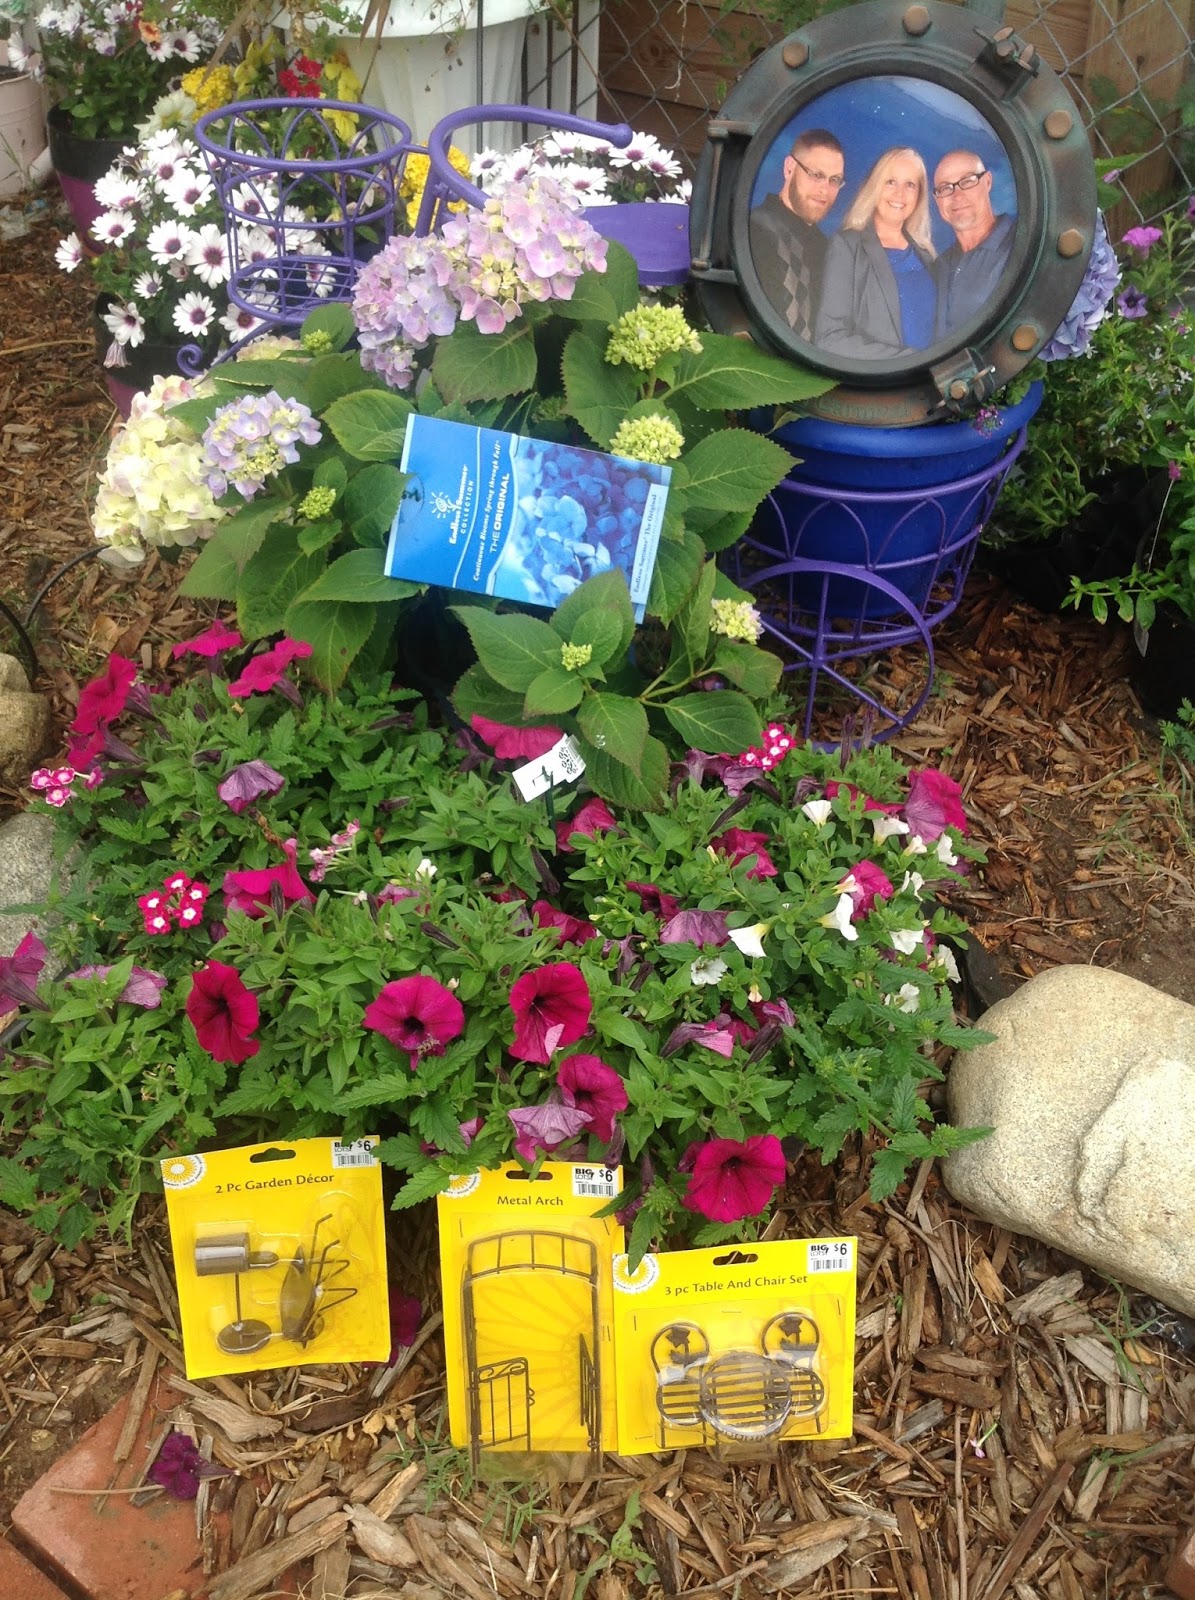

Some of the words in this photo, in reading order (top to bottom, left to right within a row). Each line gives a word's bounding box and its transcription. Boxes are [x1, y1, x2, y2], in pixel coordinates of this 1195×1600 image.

[489, 460, 500, 489] through
[460, 480, 474, 534] COLLECTION
[484, 490, 495, 514] Spring
[494, 473, 510, 531] ORIGINAL
[647, 494, 657, 522] Original
[479, 514, 490, 541] Blooms
[490, 531, 500, 553] THE
[473, 542, 485, 582] Continuous
[357, 1140, 371, 1151] $6
[215, 1185, 223, 1194] 2
[227, 1183, 241, 1192] Pc
[245, 1177, 292, 1190] Garden
[296, 1174, 335, 1185] Décor
[599, 1169, 613, 1182] $6
[497, 1196, 531, 1205] Metal
[536, 1196, 563, 1206] Arch
[810, 1244, 828, 1252] BIG
[834, 1243, 847, 1255] $6
[665, 1286, 671, 1295] 3
[675, 1287, 689, 1296] pc
[692, 1281, 724, 1292] Table
[727, 1278, 751, 1289] And
[755, 1276, 786, 1286] Chair
[789, 1275, 808, 1284] Set
